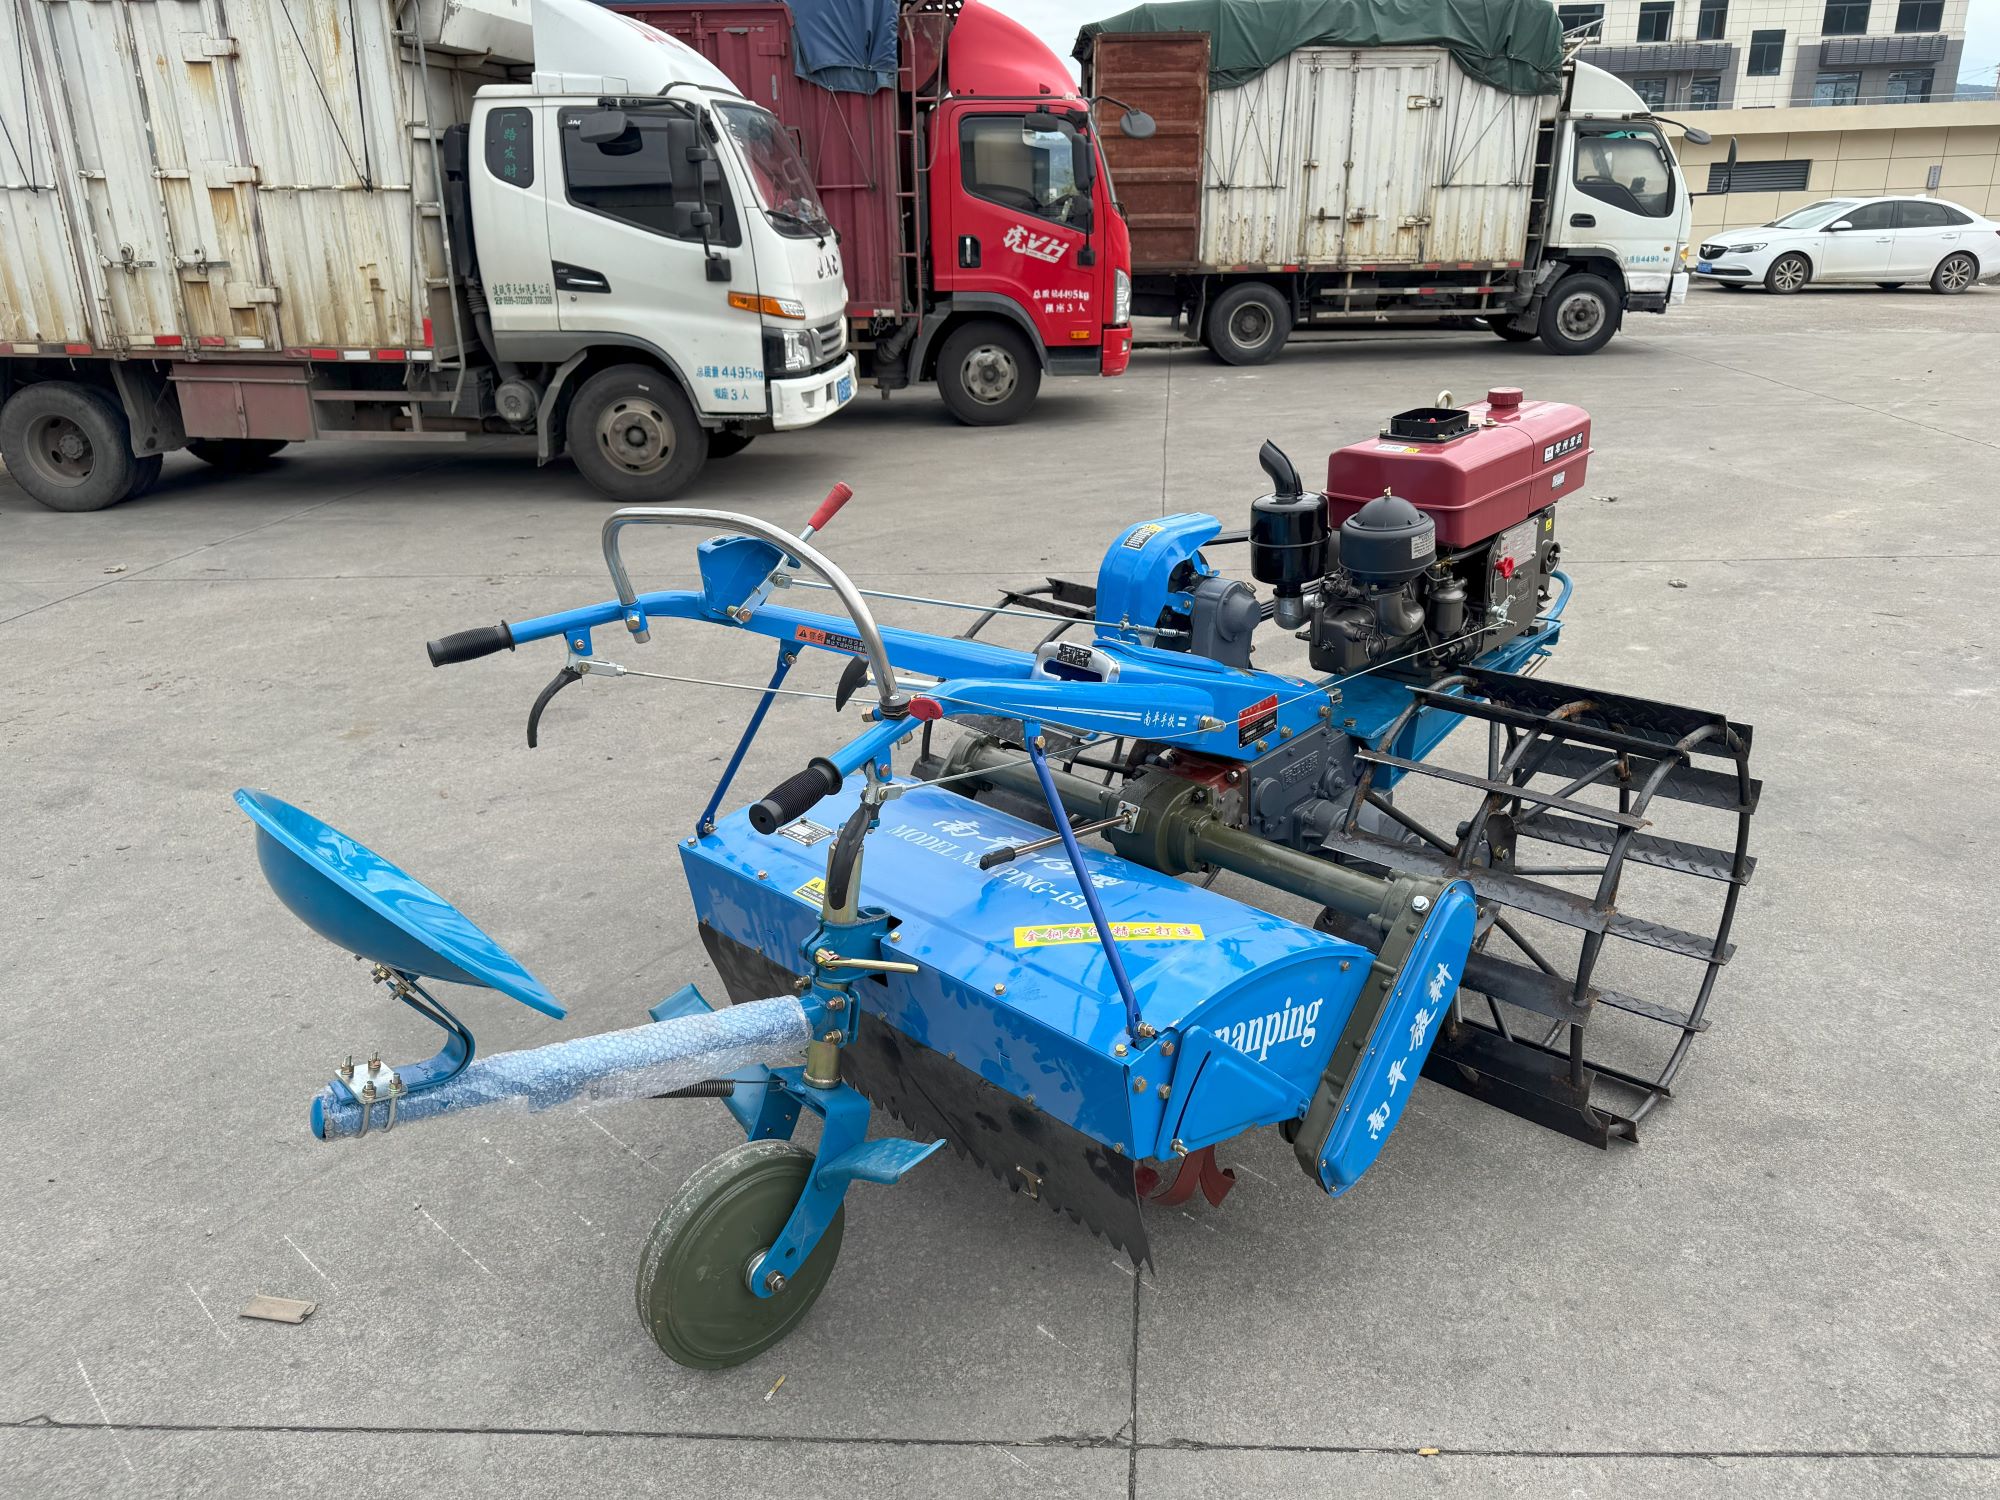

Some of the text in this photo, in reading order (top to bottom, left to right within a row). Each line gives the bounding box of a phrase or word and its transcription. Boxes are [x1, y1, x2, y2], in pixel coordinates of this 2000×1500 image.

[817, 254, 839, 280] JAC
[885, 824, 961, 858] MODEL
[1214, 996, 1324, 1063] nanping
